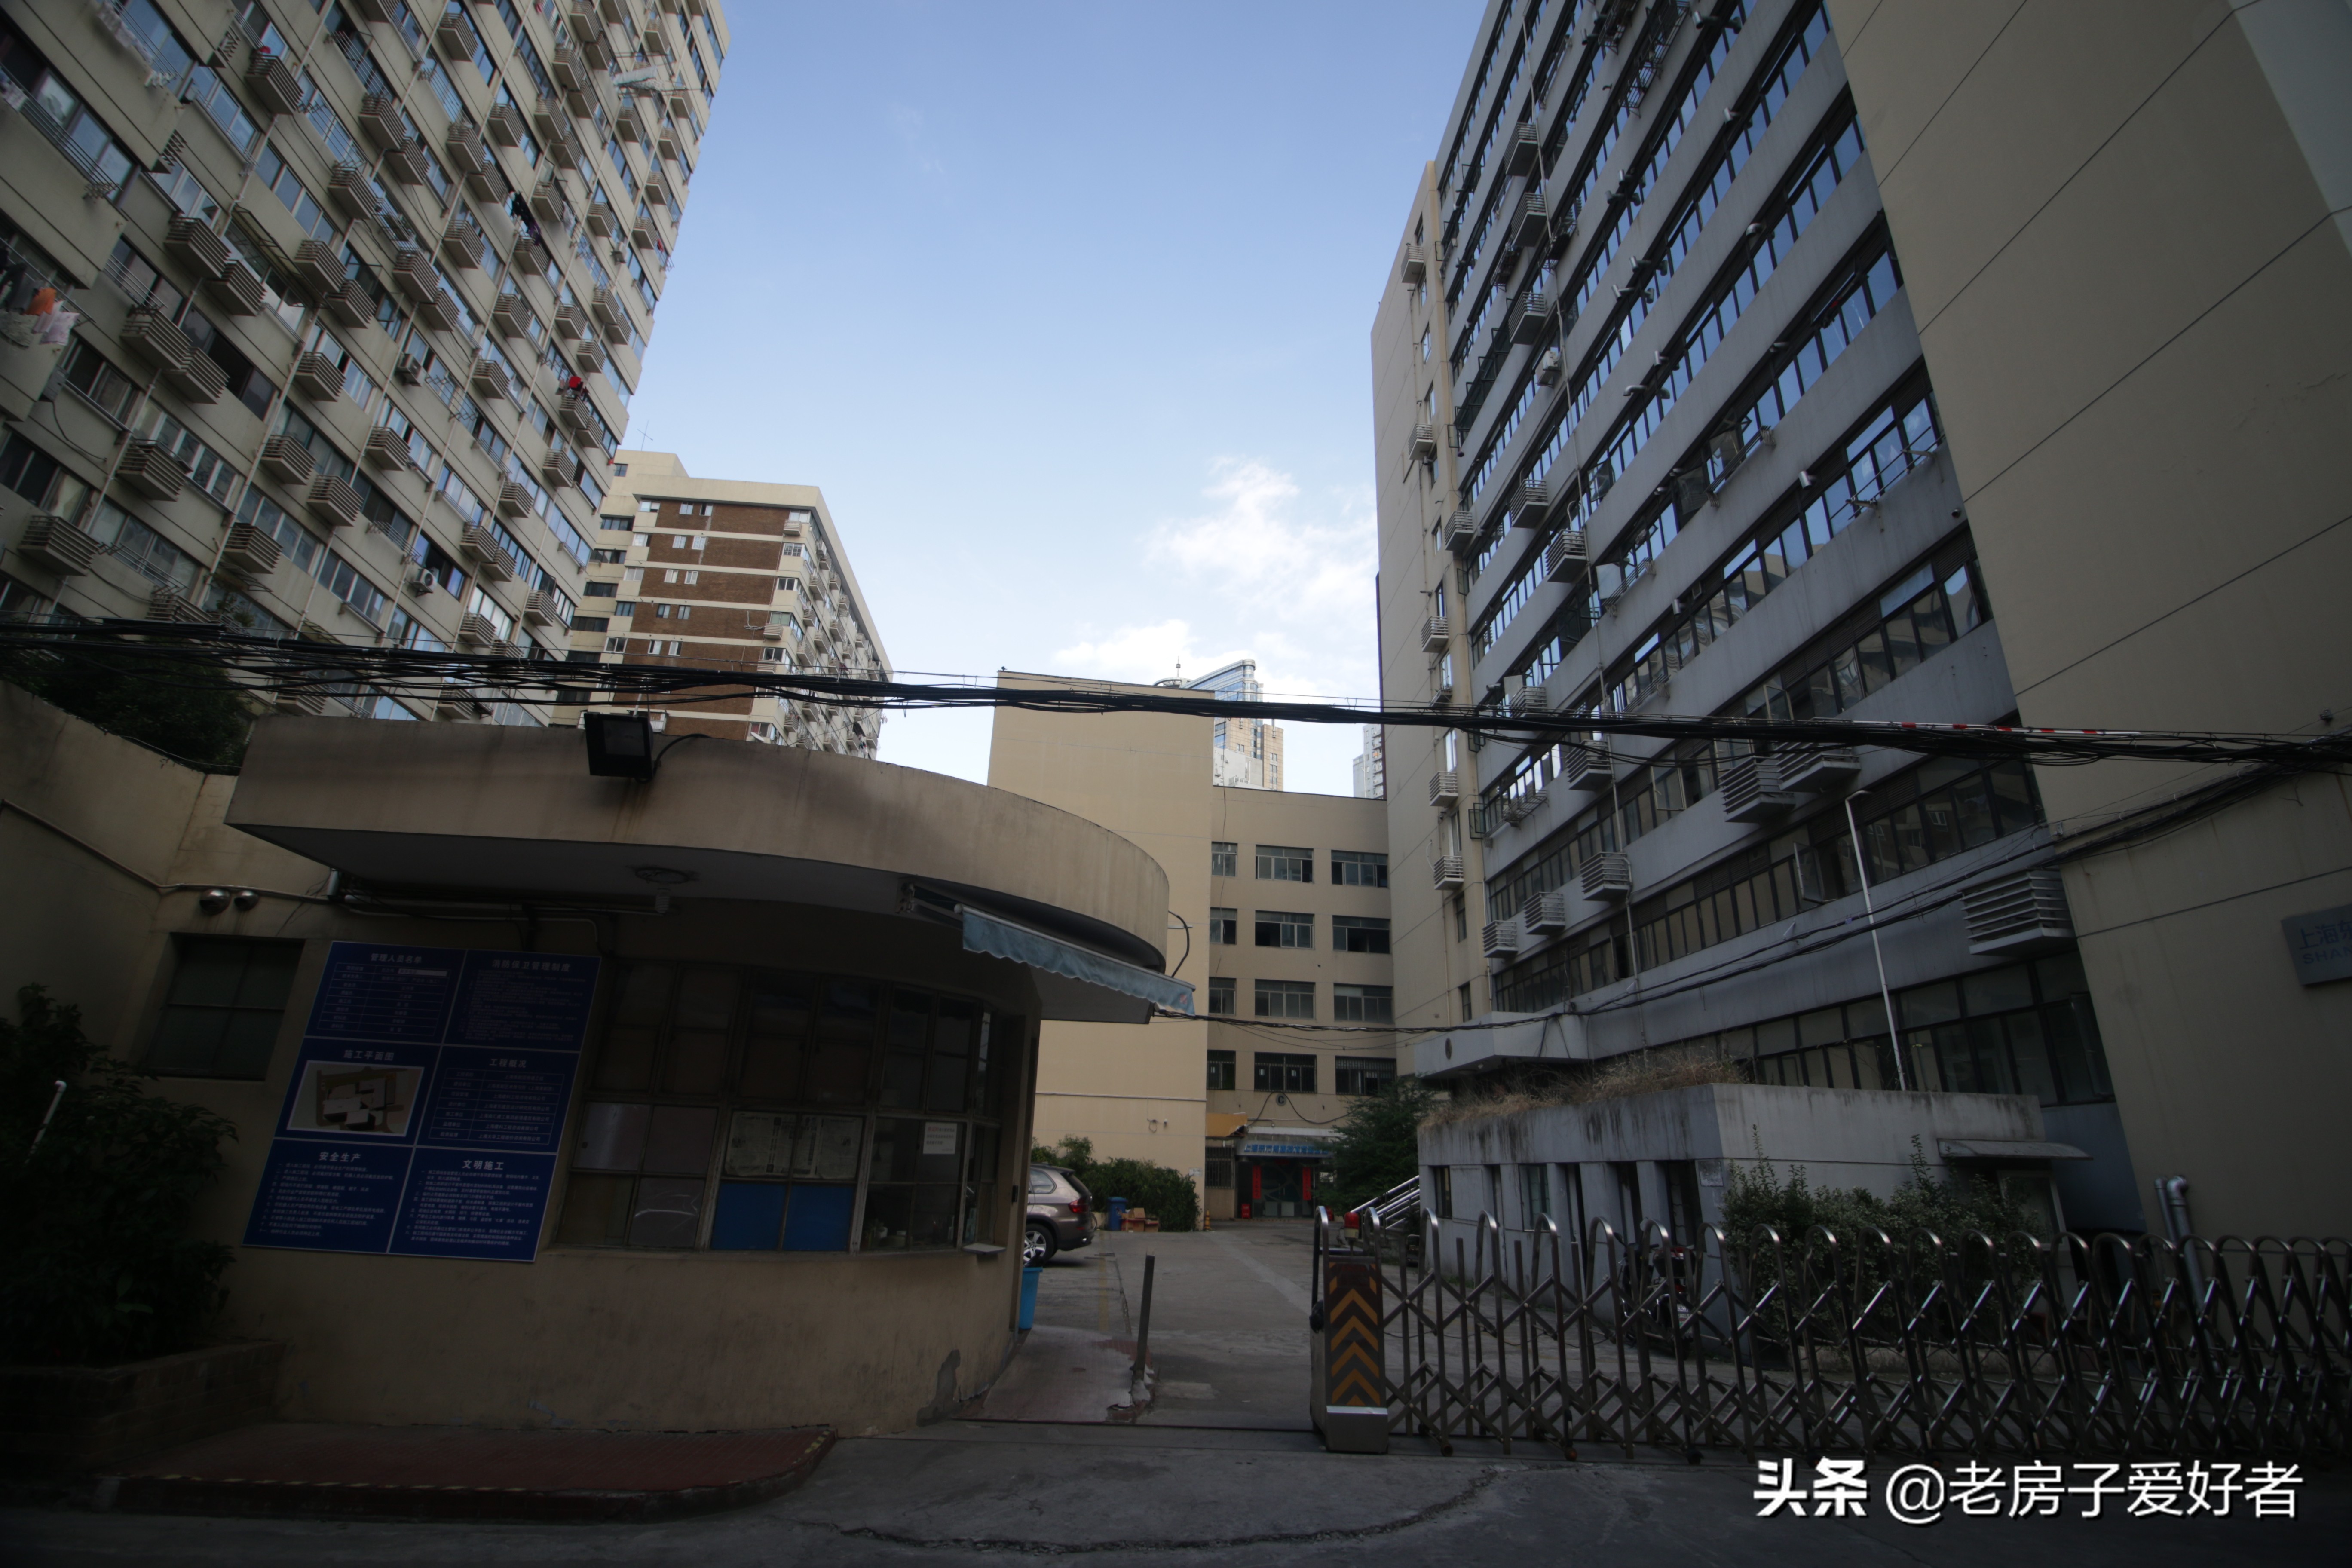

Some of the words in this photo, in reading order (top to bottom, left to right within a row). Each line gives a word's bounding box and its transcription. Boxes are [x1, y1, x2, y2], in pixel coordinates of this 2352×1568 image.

[369, 953, 423, 964] 管理人员名单
[491, 959, 571, 972] 消防保卫管理制度
[343, 1050, 395, 1061] 施工平面图
[489, 1058, 527, 1068] 工程概况
[318, 1151, 361, 1163] 安全生产
[462, 1160, 505, 1170] 文明施工
